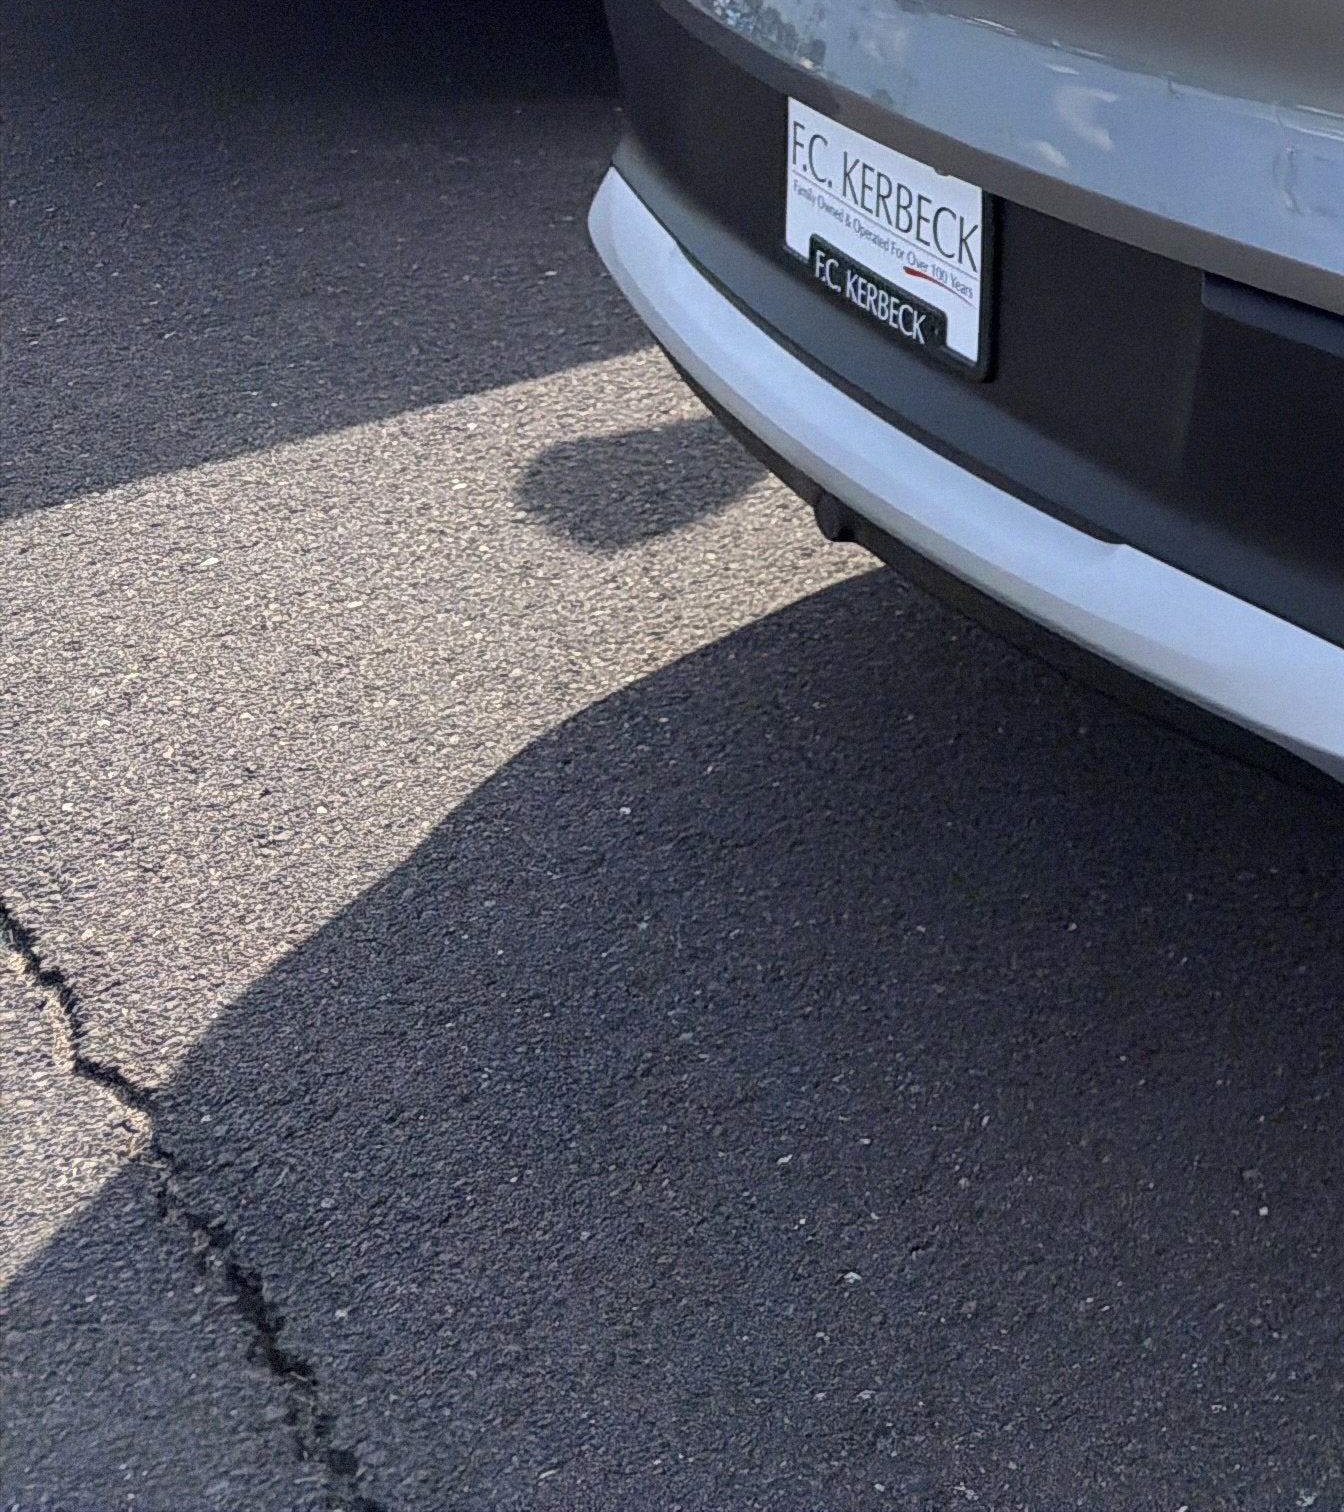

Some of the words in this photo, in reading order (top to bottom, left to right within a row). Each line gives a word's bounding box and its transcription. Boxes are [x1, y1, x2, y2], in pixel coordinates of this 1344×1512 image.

[792, 120, 833, 189] F.C.
[842, 151, 979, 273] KERBECK
[817, 194, 844, 223] Owned
[890, 241, 905, 262] For
[907, 251, 928, 273] Over
[931, 263, 949, 284] 100
[950, 272, 974, 299] Years
[845, 269, 927, 345] KERBECK
